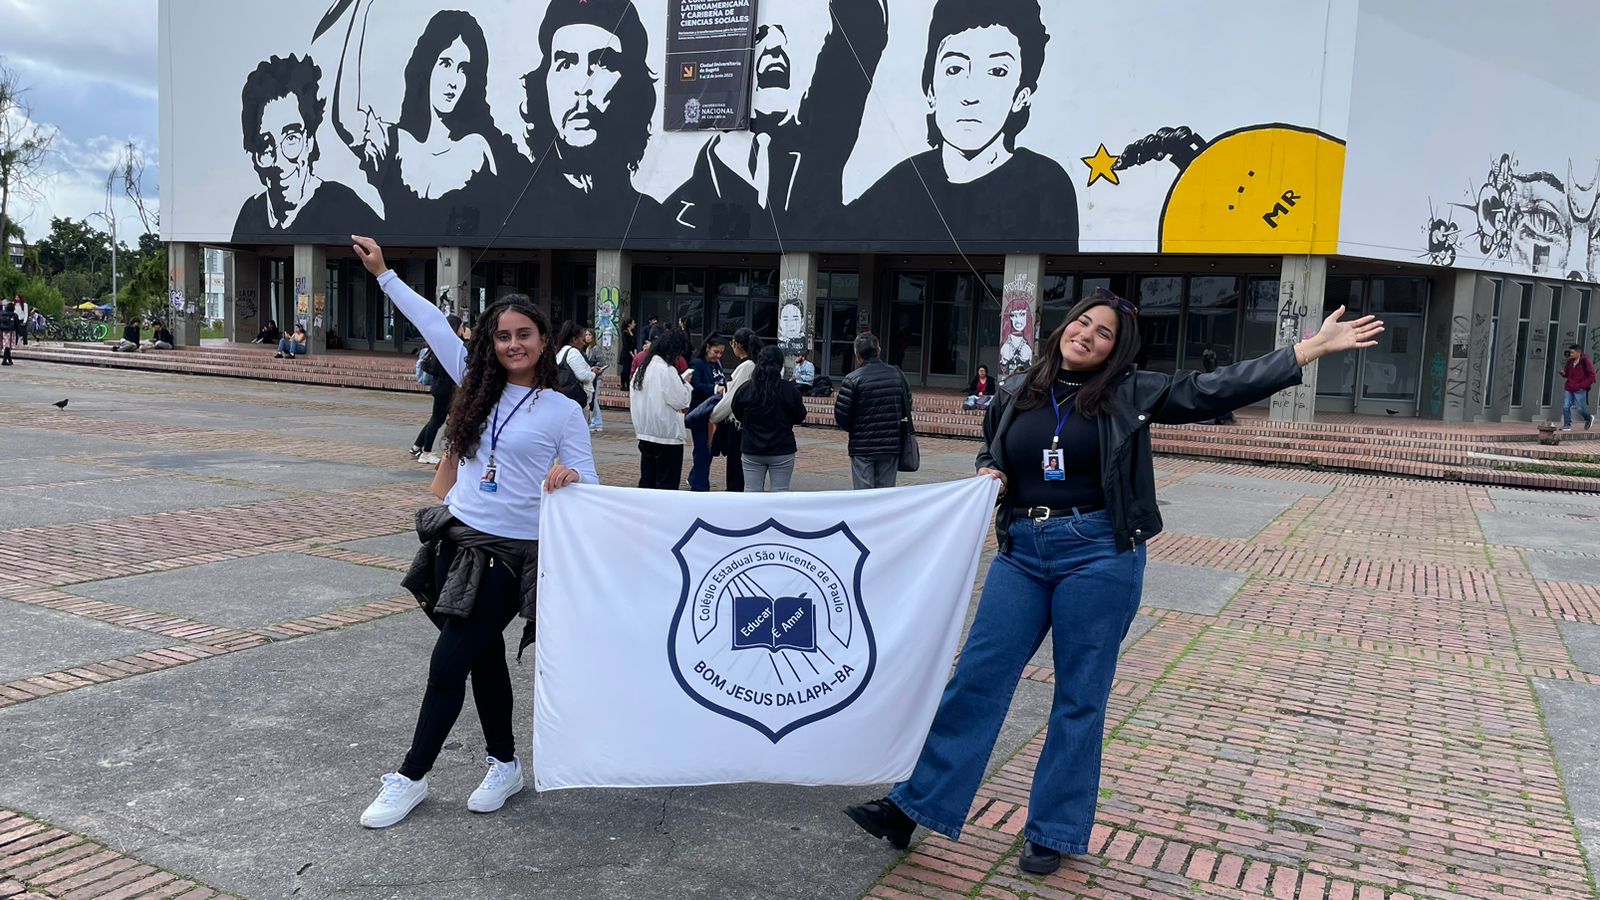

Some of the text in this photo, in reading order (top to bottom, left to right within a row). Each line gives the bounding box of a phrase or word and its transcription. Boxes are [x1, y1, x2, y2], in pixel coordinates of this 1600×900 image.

[680, 15, 749, 27] CIENCIAS SOCIALES
[681, 1, 749, 11] LATINOAMERICANA
[687, 9, 724, 19] CARIBEÑA
[724, 8, 735, 16] DE
[1263, 190, 1301, 228] MR
[699, 550, 844, 621] Colégio Estadual São Vicente de Paulo
[740, 606, 773, 638] Educar
[781, 606, 806, 633] Amar
[693, 660, 728, 690] BOM
[726, 683, 774, 707] JESUS
[776, 692, 797, 707] DA
